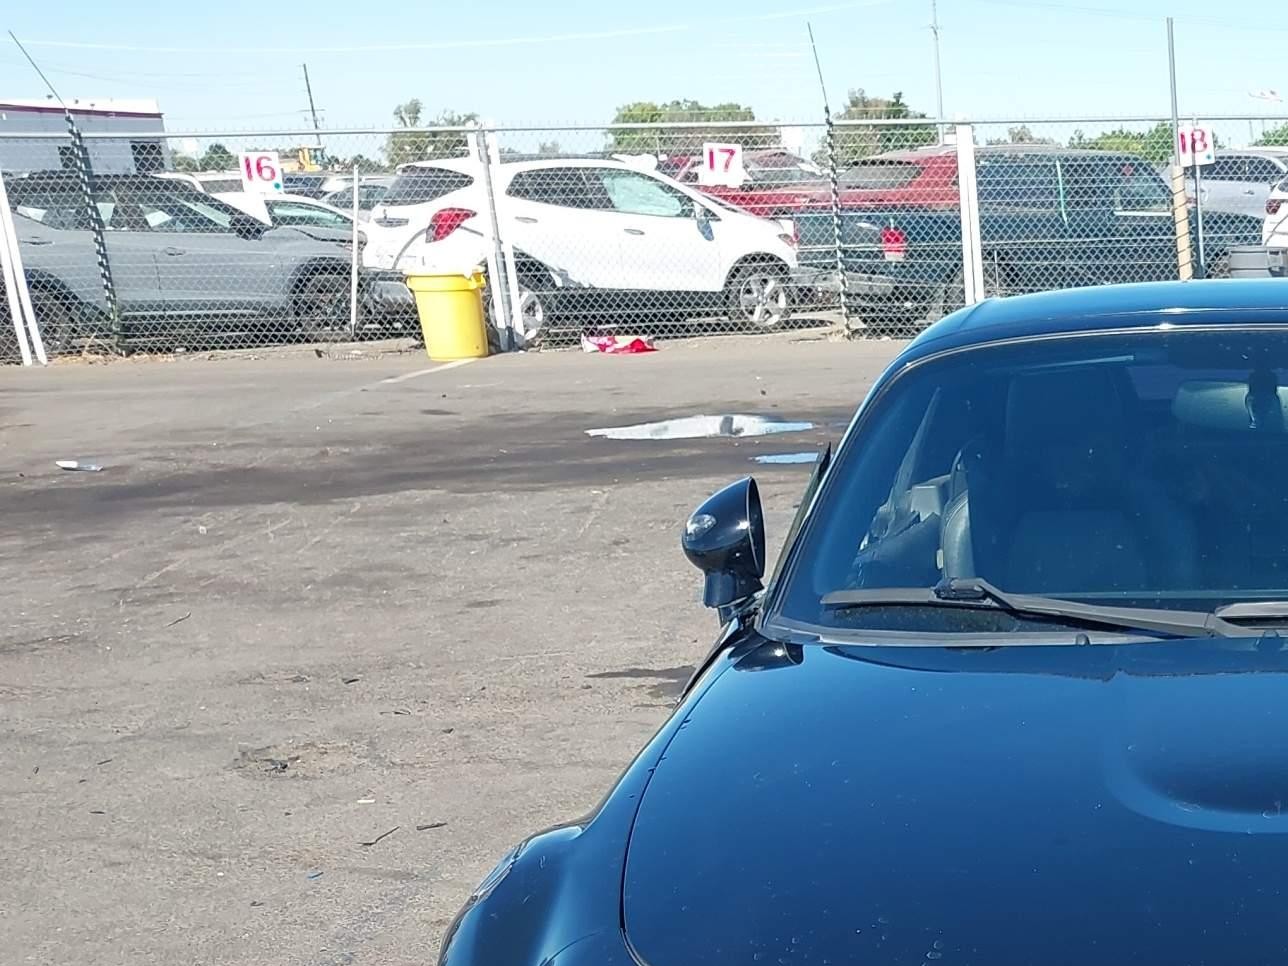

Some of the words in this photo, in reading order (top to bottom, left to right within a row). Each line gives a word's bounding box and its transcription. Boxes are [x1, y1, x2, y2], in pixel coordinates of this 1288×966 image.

[1179, 129, 1208, 154] 18
[244, 156, 276, 181] 16
[708, 148, 736, 172] 17
